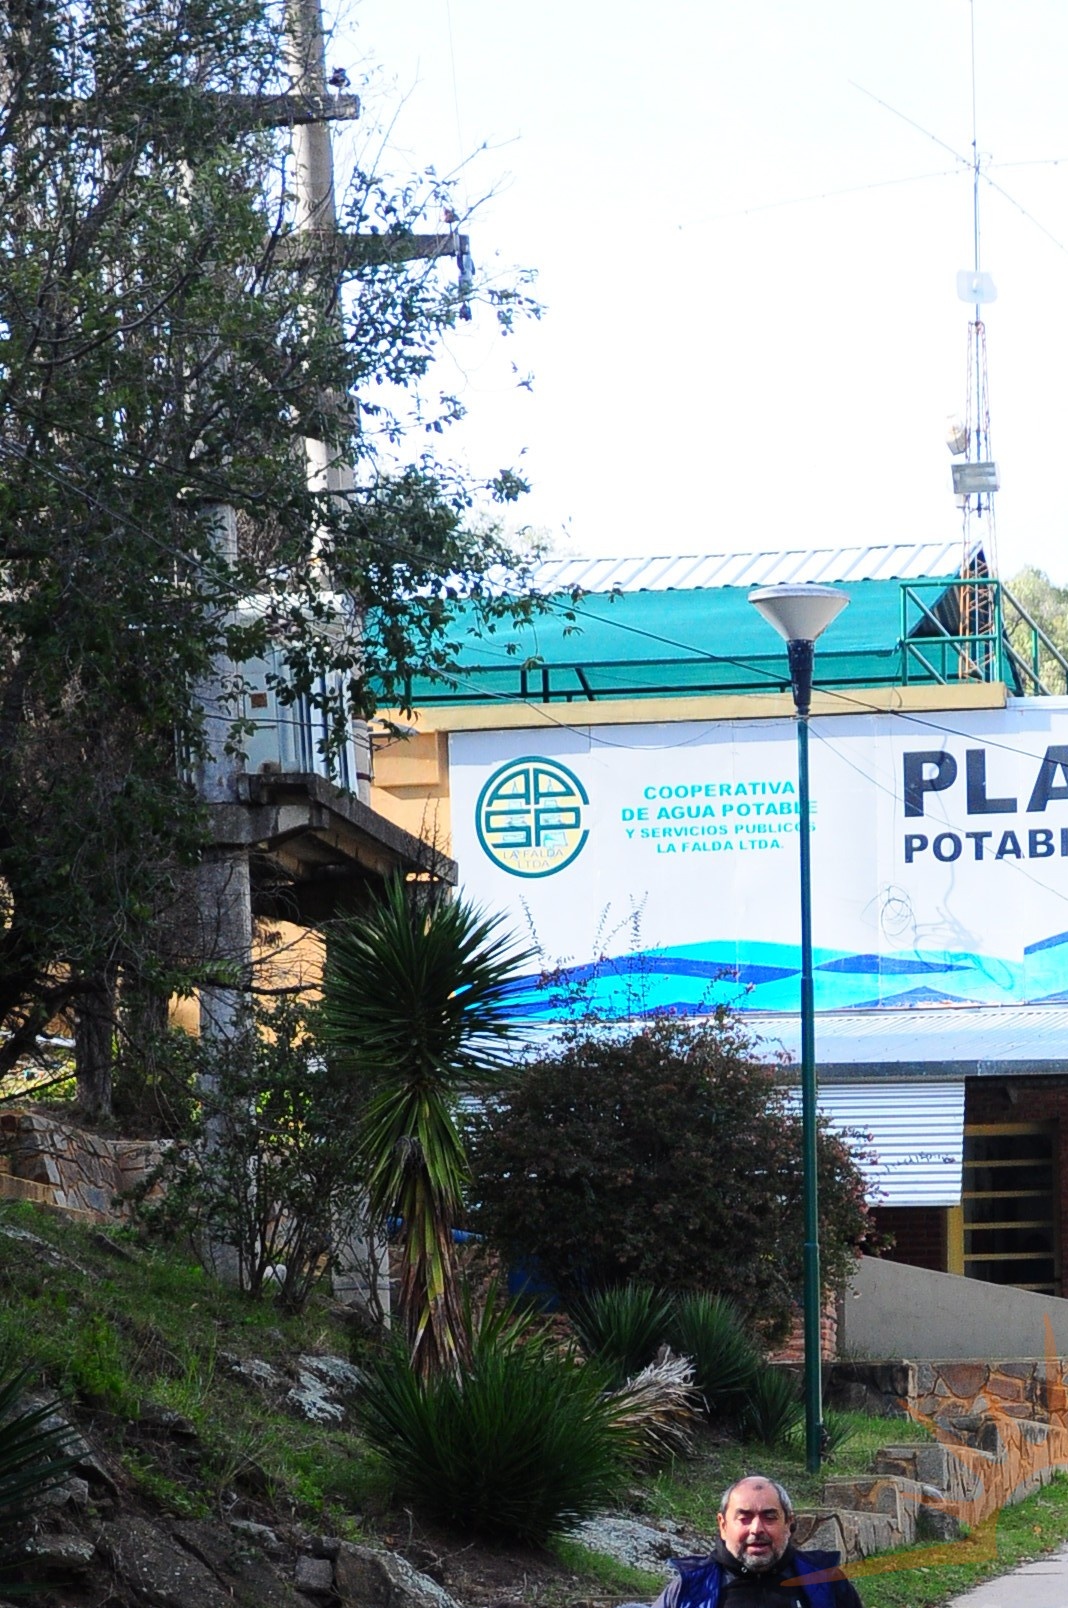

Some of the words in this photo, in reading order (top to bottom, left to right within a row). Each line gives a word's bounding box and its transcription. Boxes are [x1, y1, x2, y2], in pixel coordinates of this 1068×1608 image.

[643, 780, 796, 800] COOPERATIVA
[621, 806, 649, 822] DE
[657, 804, 716, 820] AGUA
[625, 828, 636, 839] Y
[640, 824, 728, 839] SERVICIOS
[503, 850, 518, 859] LA
[523, 848, 564, 859] FALDA
[656, 842, 677, 854] LA
[681, 840, 734, 853] FALDA
[739, 838, 785, 851] LTDA.
[518, 859, 550, 869] LTDA
